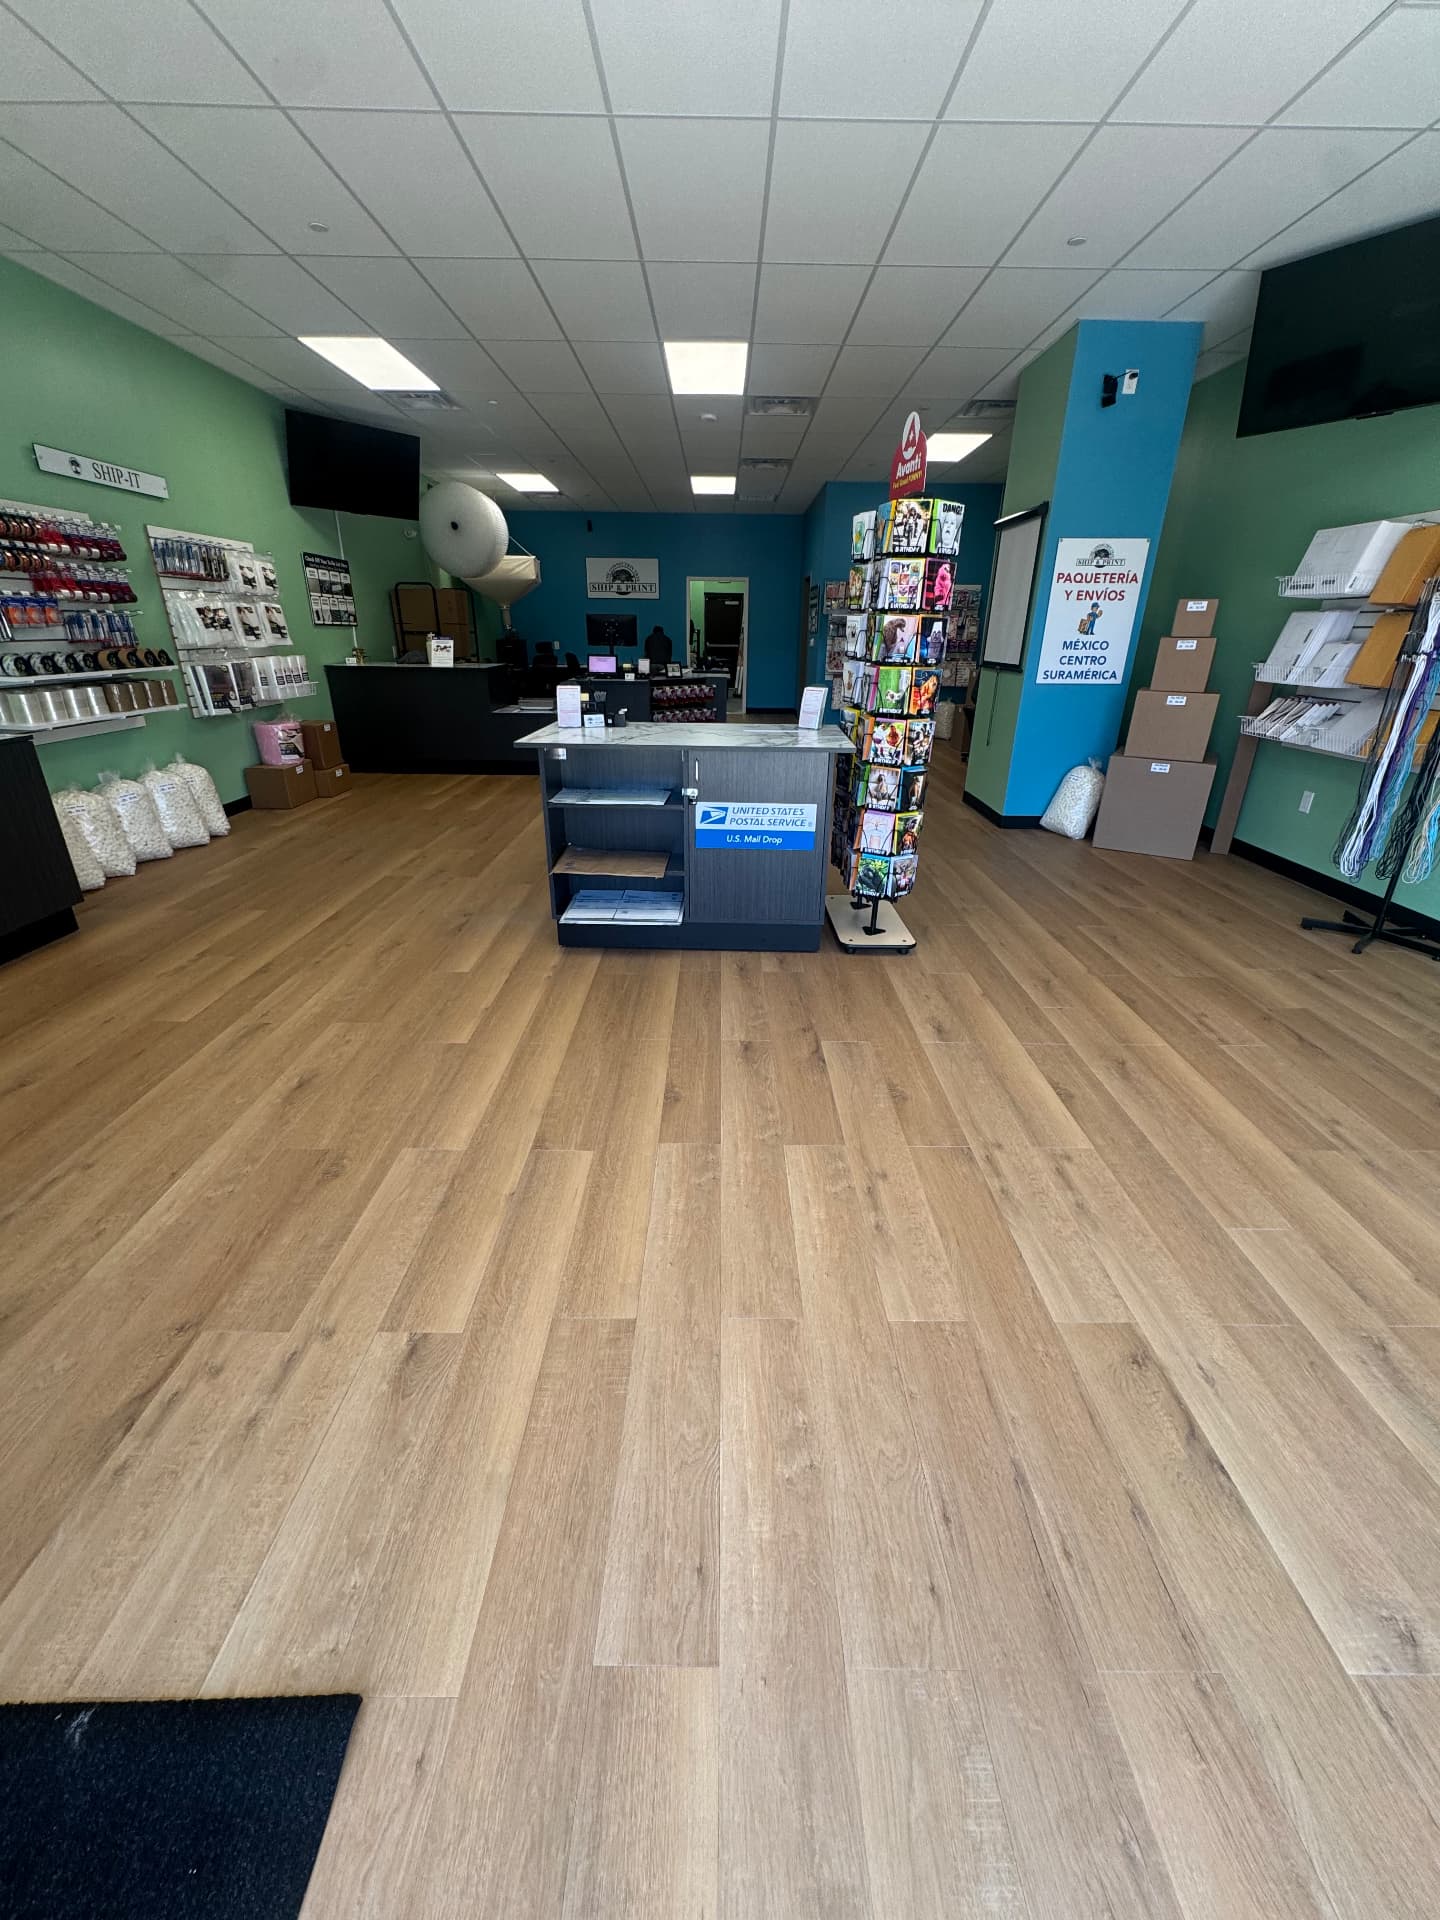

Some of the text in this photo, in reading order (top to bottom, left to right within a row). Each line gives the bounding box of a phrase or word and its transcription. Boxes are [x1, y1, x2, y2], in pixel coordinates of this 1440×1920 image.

[896, 452, 922, 480] Avanti
[92, 462, 141, 489] SHIP-IT
[942, 503, 964, 515] DANG!
[1056, 570, 1138, 584] PAQUETERÍA
[591, 583, 614, 592] SHIP
[625, 584, 655, 592] PRINT
[1065, 587, 1126, 601] Y ENVÍOS
[1062, 638, 1109, 651] MÉXICO
[1059, 655, 1107, 666] CENTRO
[1042, 668, 1117, 680] SURAMÉRICA
[732, 807, 805, 816] UNITED STATES
[729, 817, 807, 827] POSTAL SERVICE
[726, 834, 783, 846] U.S. Mail Drop
